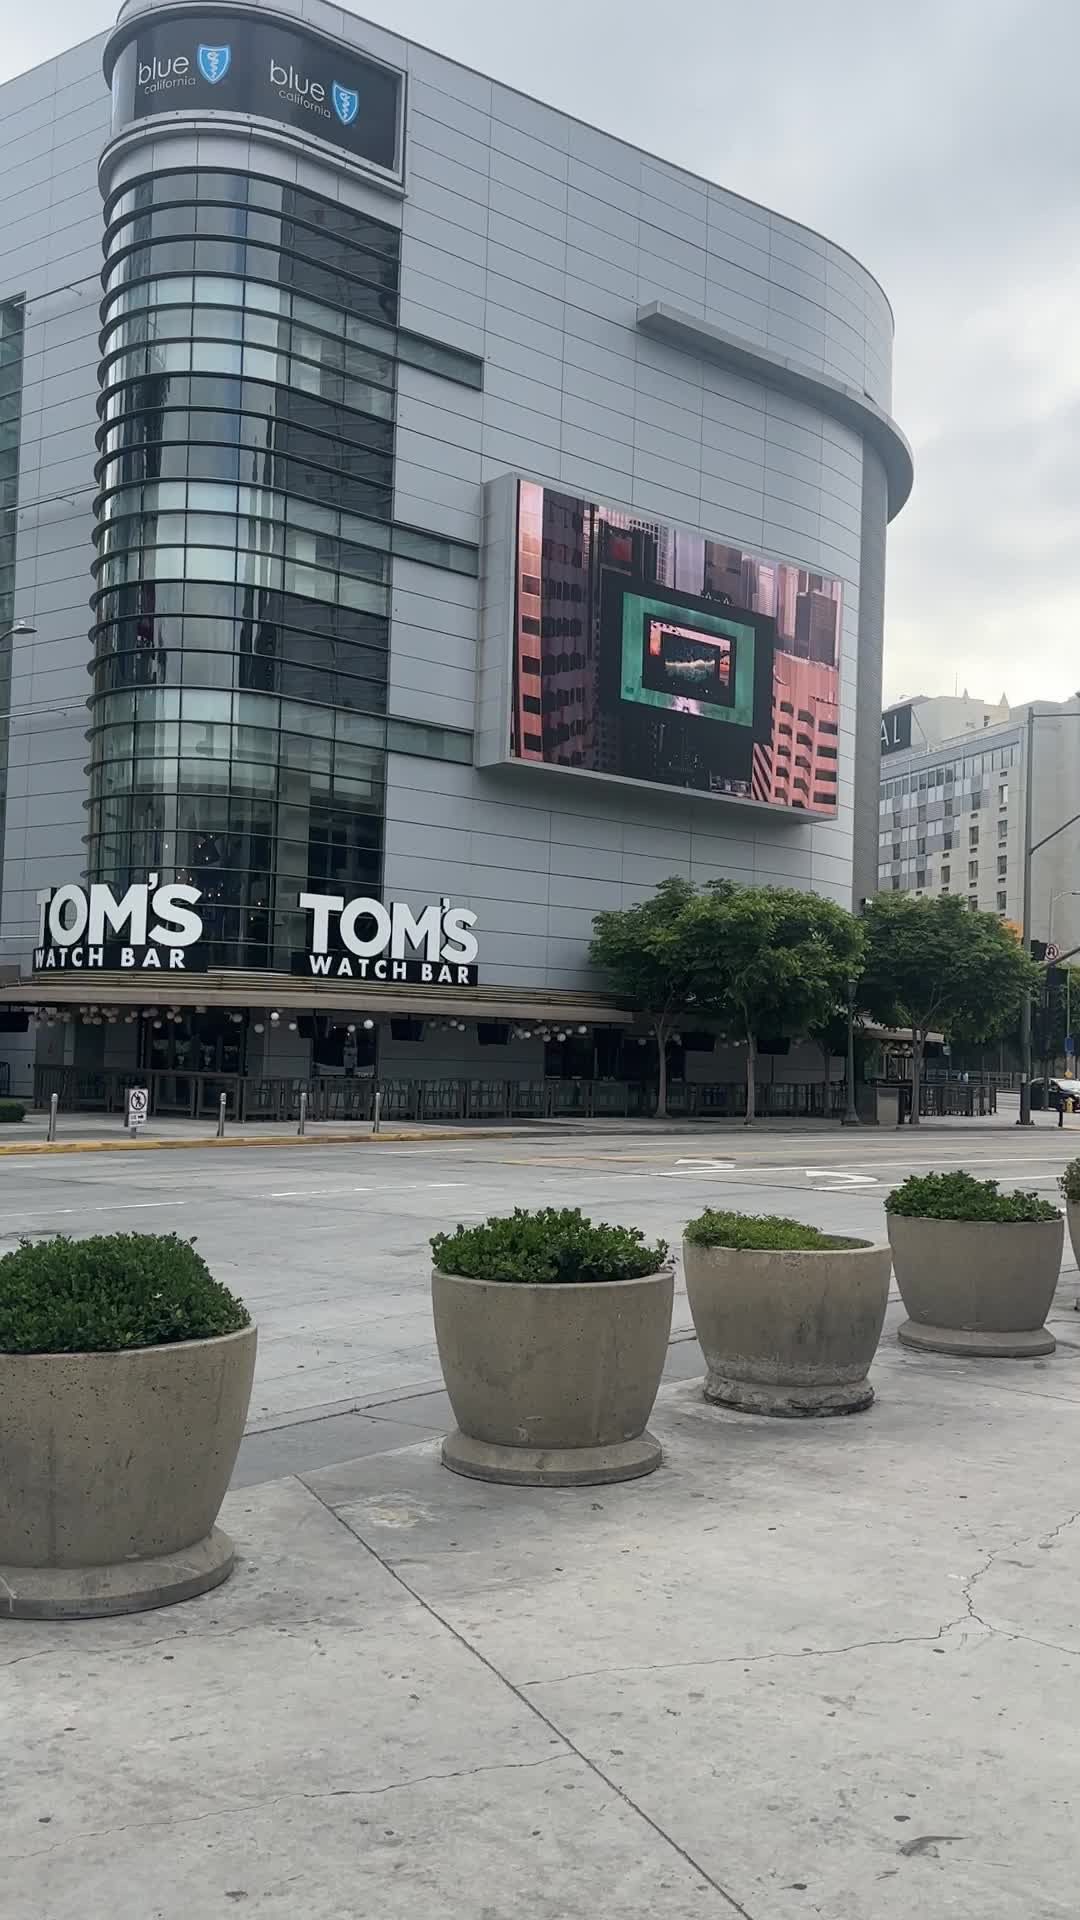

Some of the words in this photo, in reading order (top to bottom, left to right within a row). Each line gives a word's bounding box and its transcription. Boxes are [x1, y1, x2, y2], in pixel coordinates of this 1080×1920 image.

[138, 56, 190, 86] blue
[143, 76, 197, 95] california
[269, 59, 326, 103] blue
[278, 89, 331, 119] california
[36, 872, 203, 947] TOM'S
[299, 892, 479, 965] TOM'S
[35, 947, 104, 969] WATCH
[120, 948, 186, 969] BAR
[308, 955, 407, 980] WATCH
[421, 963, 470, 985] BAR
